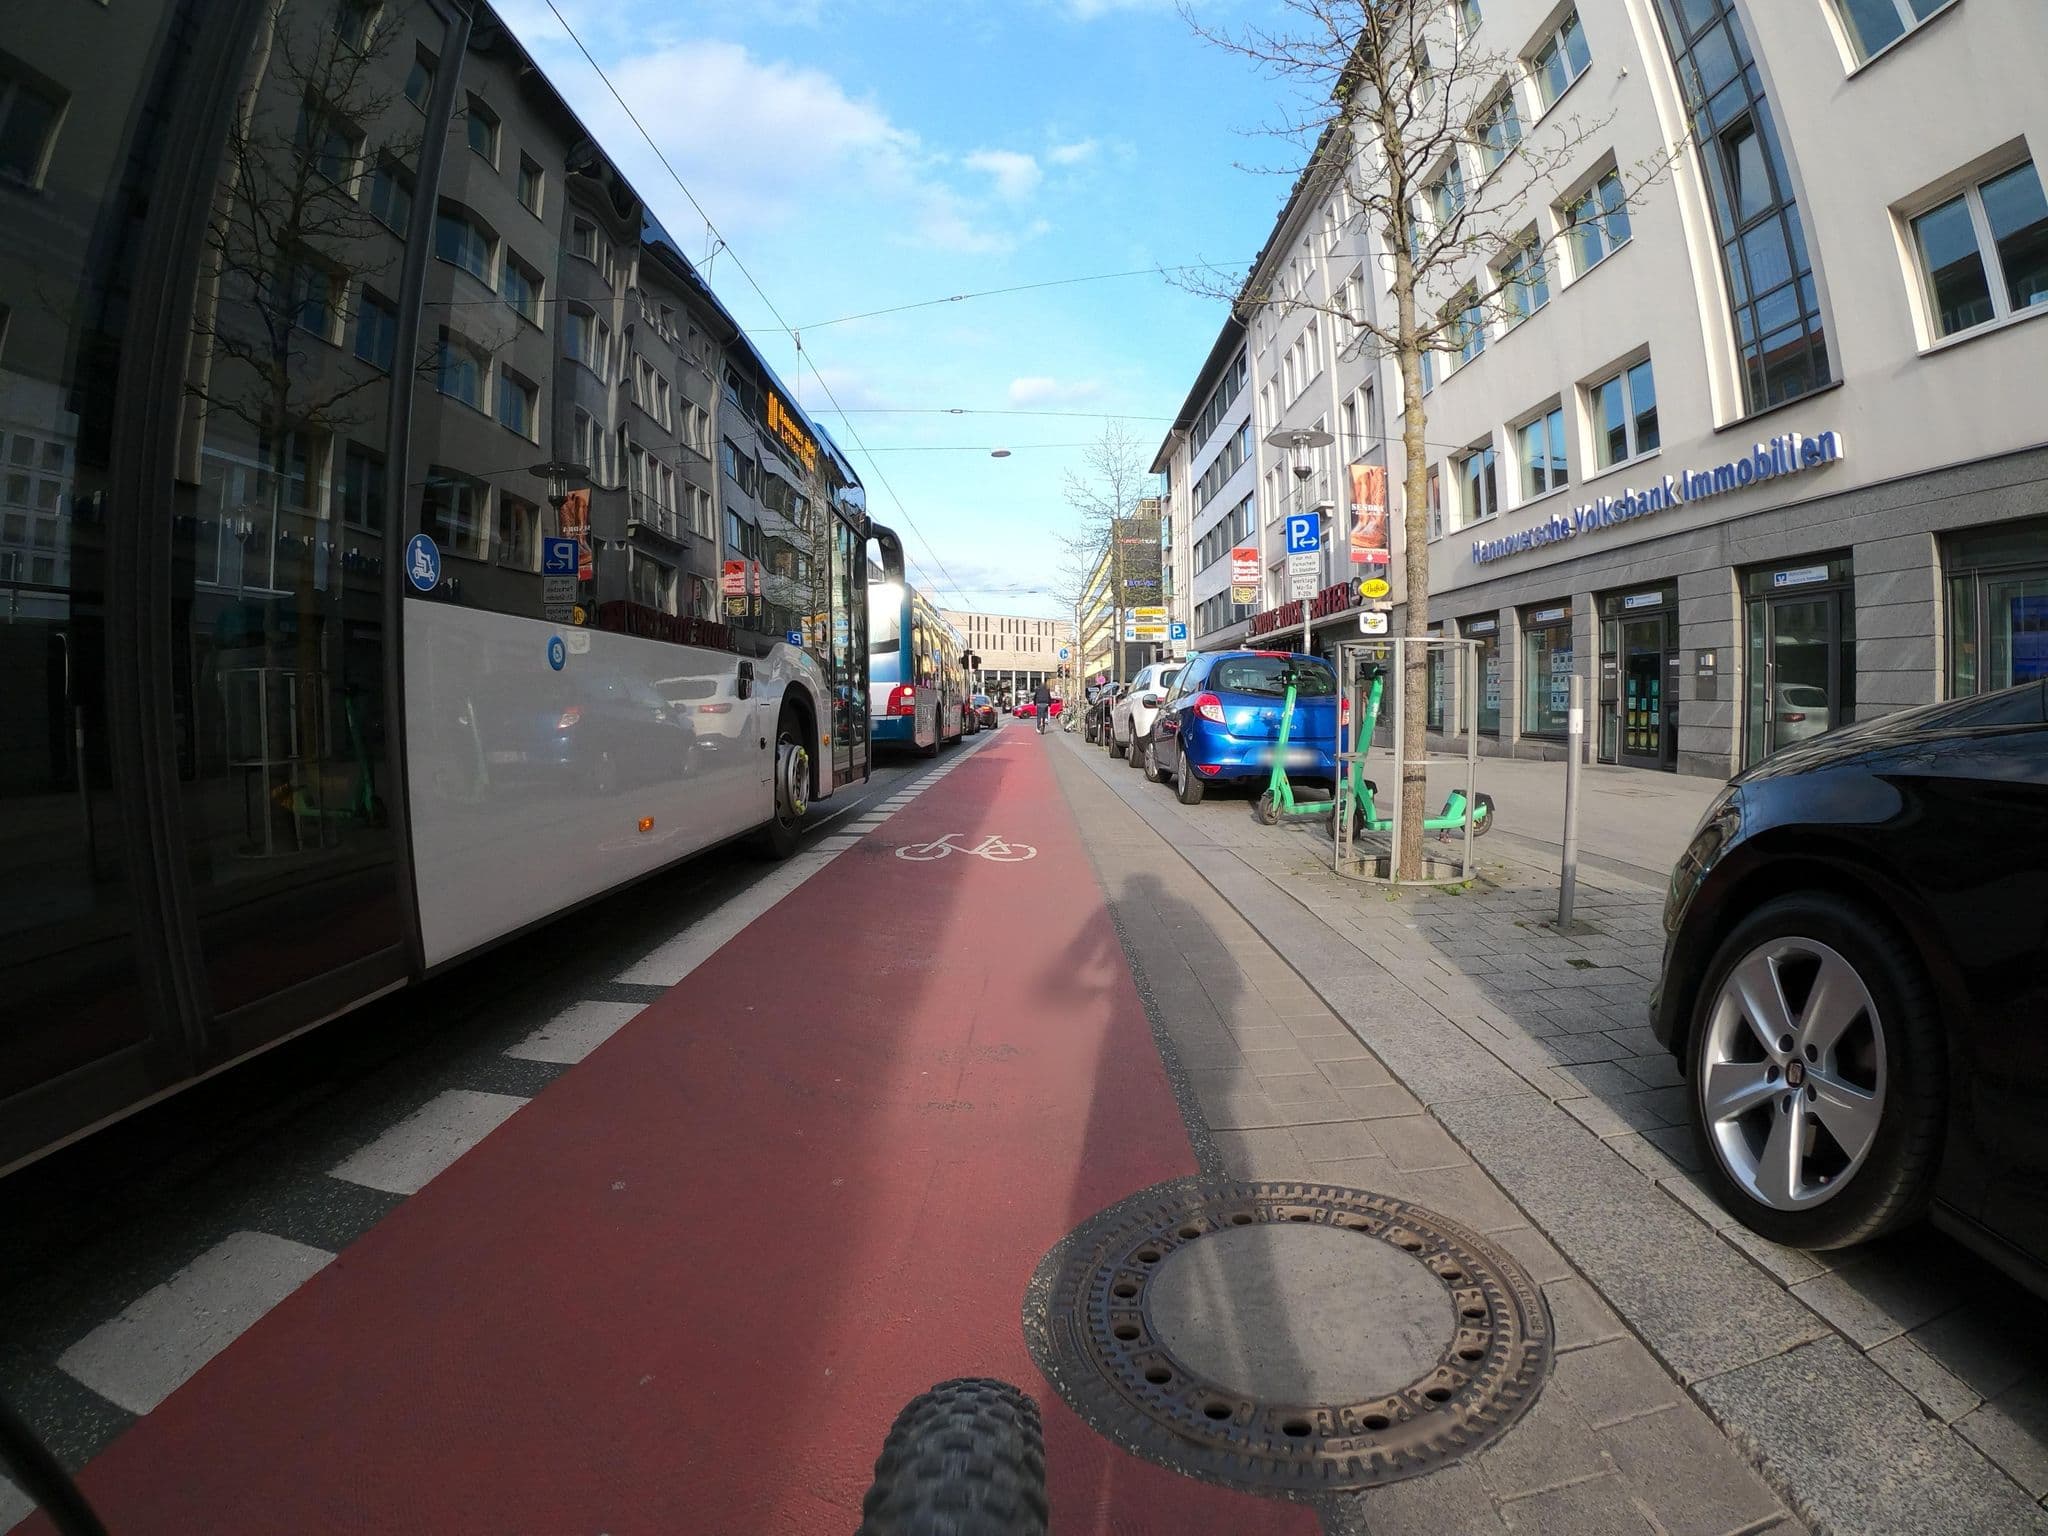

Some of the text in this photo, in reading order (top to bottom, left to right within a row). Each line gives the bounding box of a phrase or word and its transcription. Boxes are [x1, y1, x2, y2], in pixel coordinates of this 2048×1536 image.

[1472, 431, 1841, 563] Hannoversche Volksbank Immobilien
[1292, 519, 1310, 549] P
[1308, 582, 1350, 622] ENTER
[1172, 625, 1182, 639] P
